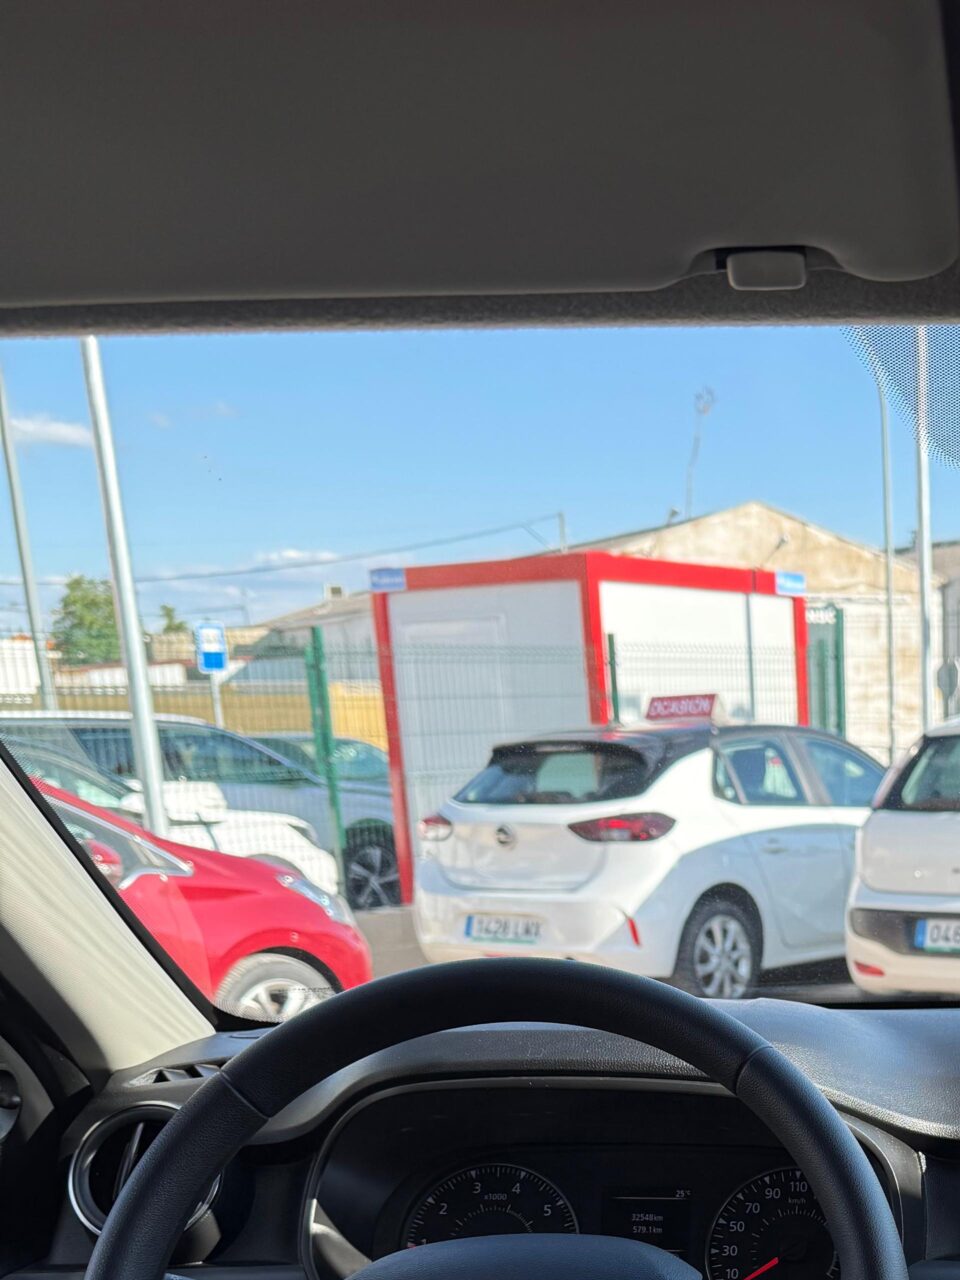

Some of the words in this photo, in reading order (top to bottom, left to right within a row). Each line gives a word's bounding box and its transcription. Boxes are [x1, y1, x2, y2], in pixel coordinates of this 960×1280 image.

[472, 1183, 481, 1194] 3
[512, 1183, 521, 1194] 4
[790, 1181, 808, 1192] 110
[765, 1188, 781, 1199] 90
[439, 1203, 448, 1215] 2
[543, 1204, 552, 1216] 5
[745, 1203, 760, 1213] 70
[729, 1221, 745, 1232] 50
[721, 1246, 738, 1256] 30
[726, 1268, 739, 1279] 10
